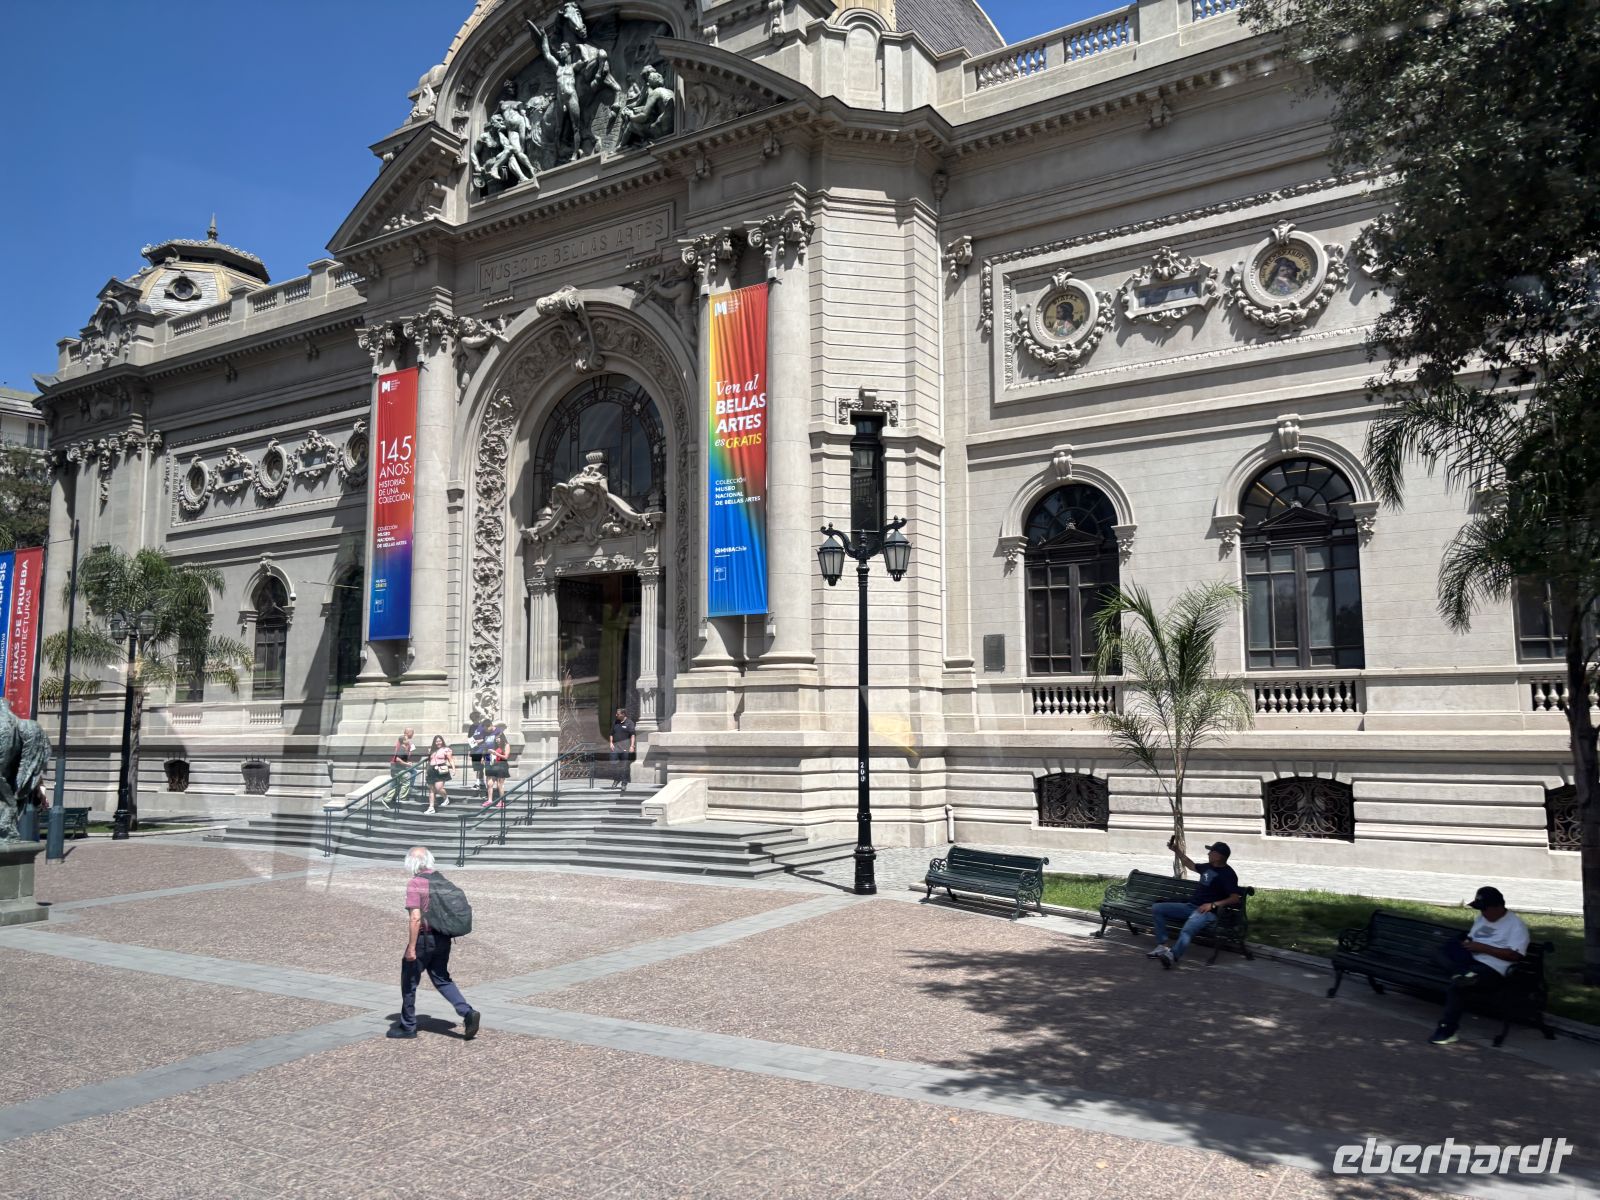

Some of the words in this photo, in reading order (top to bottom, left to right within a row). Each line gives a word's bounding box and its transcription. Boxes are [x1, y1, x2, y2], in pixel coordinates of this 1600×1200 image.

[483, 257, 528, 282] MUSEO
[553, 234, 607, 264] BELLAS
[615, 218, 663, 249] ARTES
[712, 380, 741, 396] Ven
[744, 373, 759, 392] al
[715, 392, 767, 415] BELLAS
[715, 413, 762, 434] ARTES
[380, 435, 412, 465] 145
[714, 438, 726, 447] es
[725, 432, 762, 449] GRATIS
[379, 462, 412, 479] AÑOS:
[378, 477, 406, 489] HISTORIAS
[378, 489, 386, 497] DE
[386, 486, 400, 496] UNA
[378, 492, 411, 505] COLECCIÓN
[17, 560, 29, 615] PRUEBA
[15, 619, 22, 637] DE
[19, 589, 32, 682] ARQUITECTURAS
[12, 642, 20, 680] TIRAS
